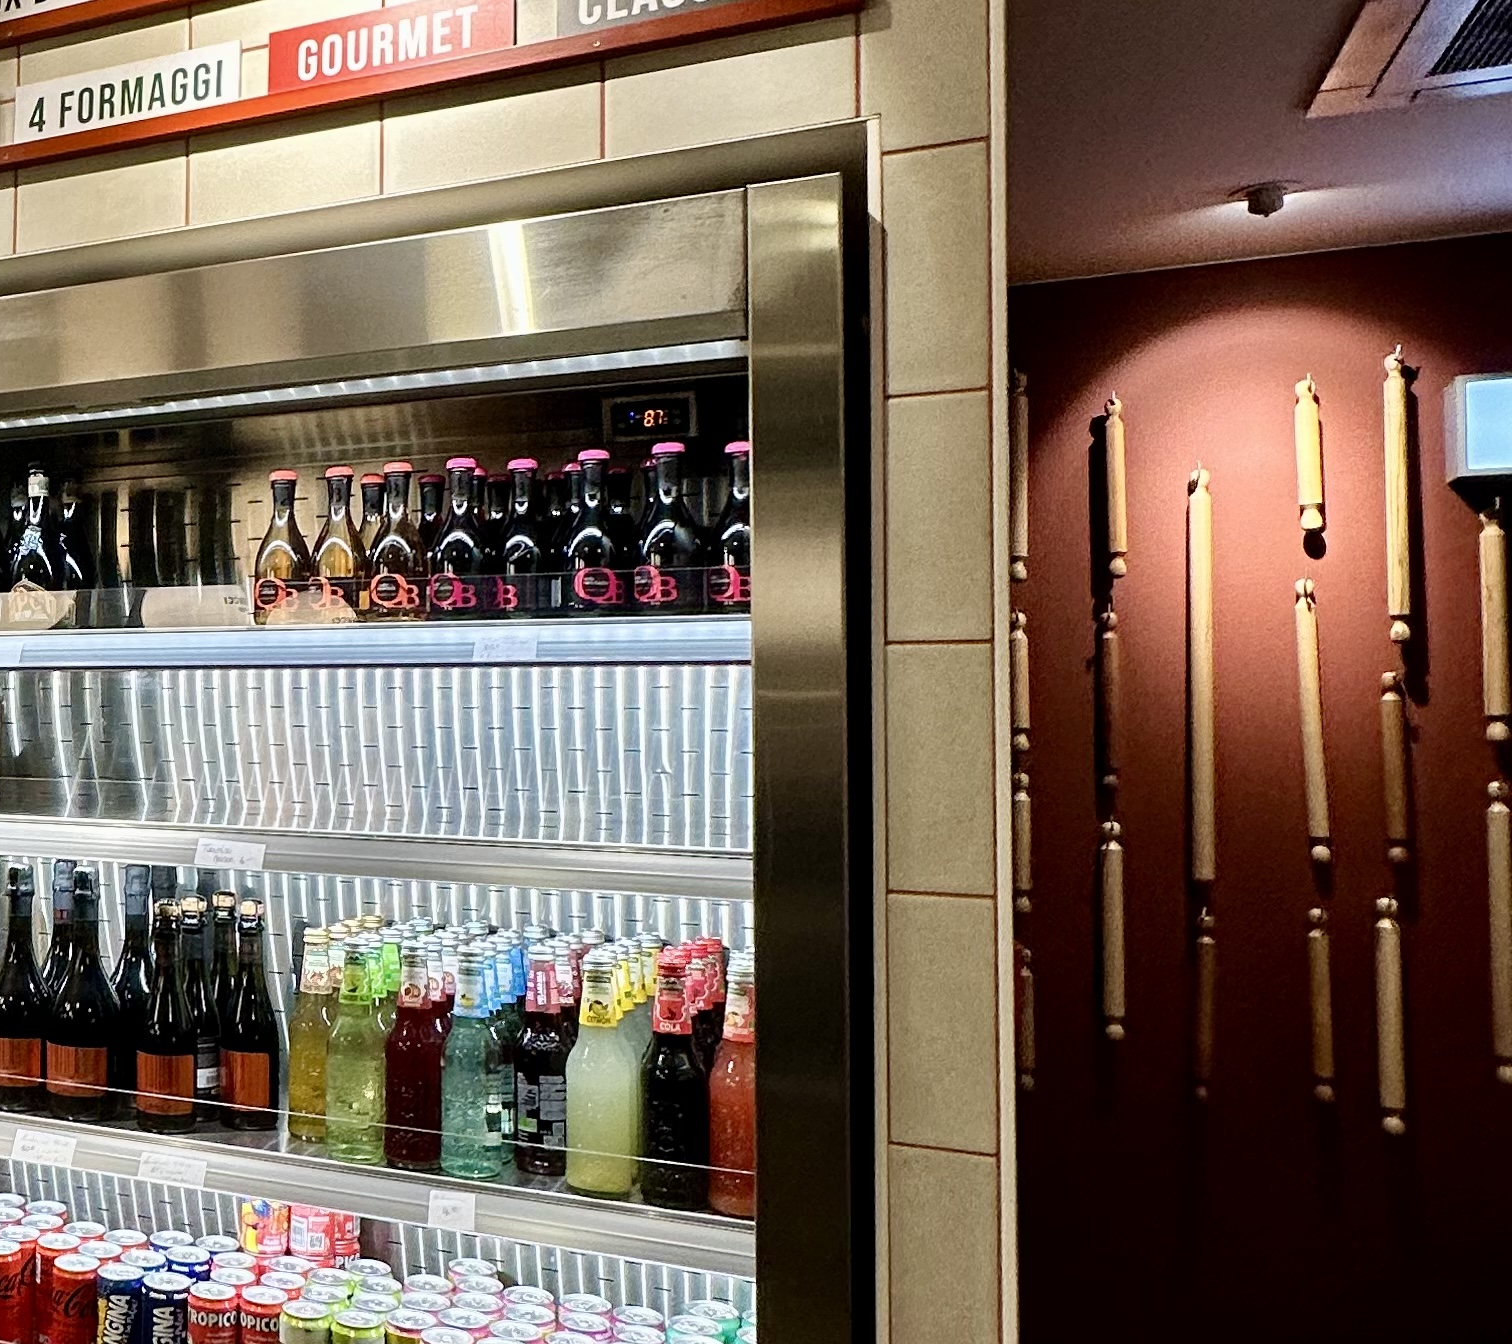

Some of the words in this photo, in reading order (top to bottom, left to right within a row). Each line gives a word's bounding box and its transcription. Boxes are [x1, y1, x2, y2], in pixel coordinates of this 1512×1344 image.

[297, 4, 479, 82] GOURMET
[28, 95, 46, 133] 4
[58, 59, 224, 127] FORMAGGI
